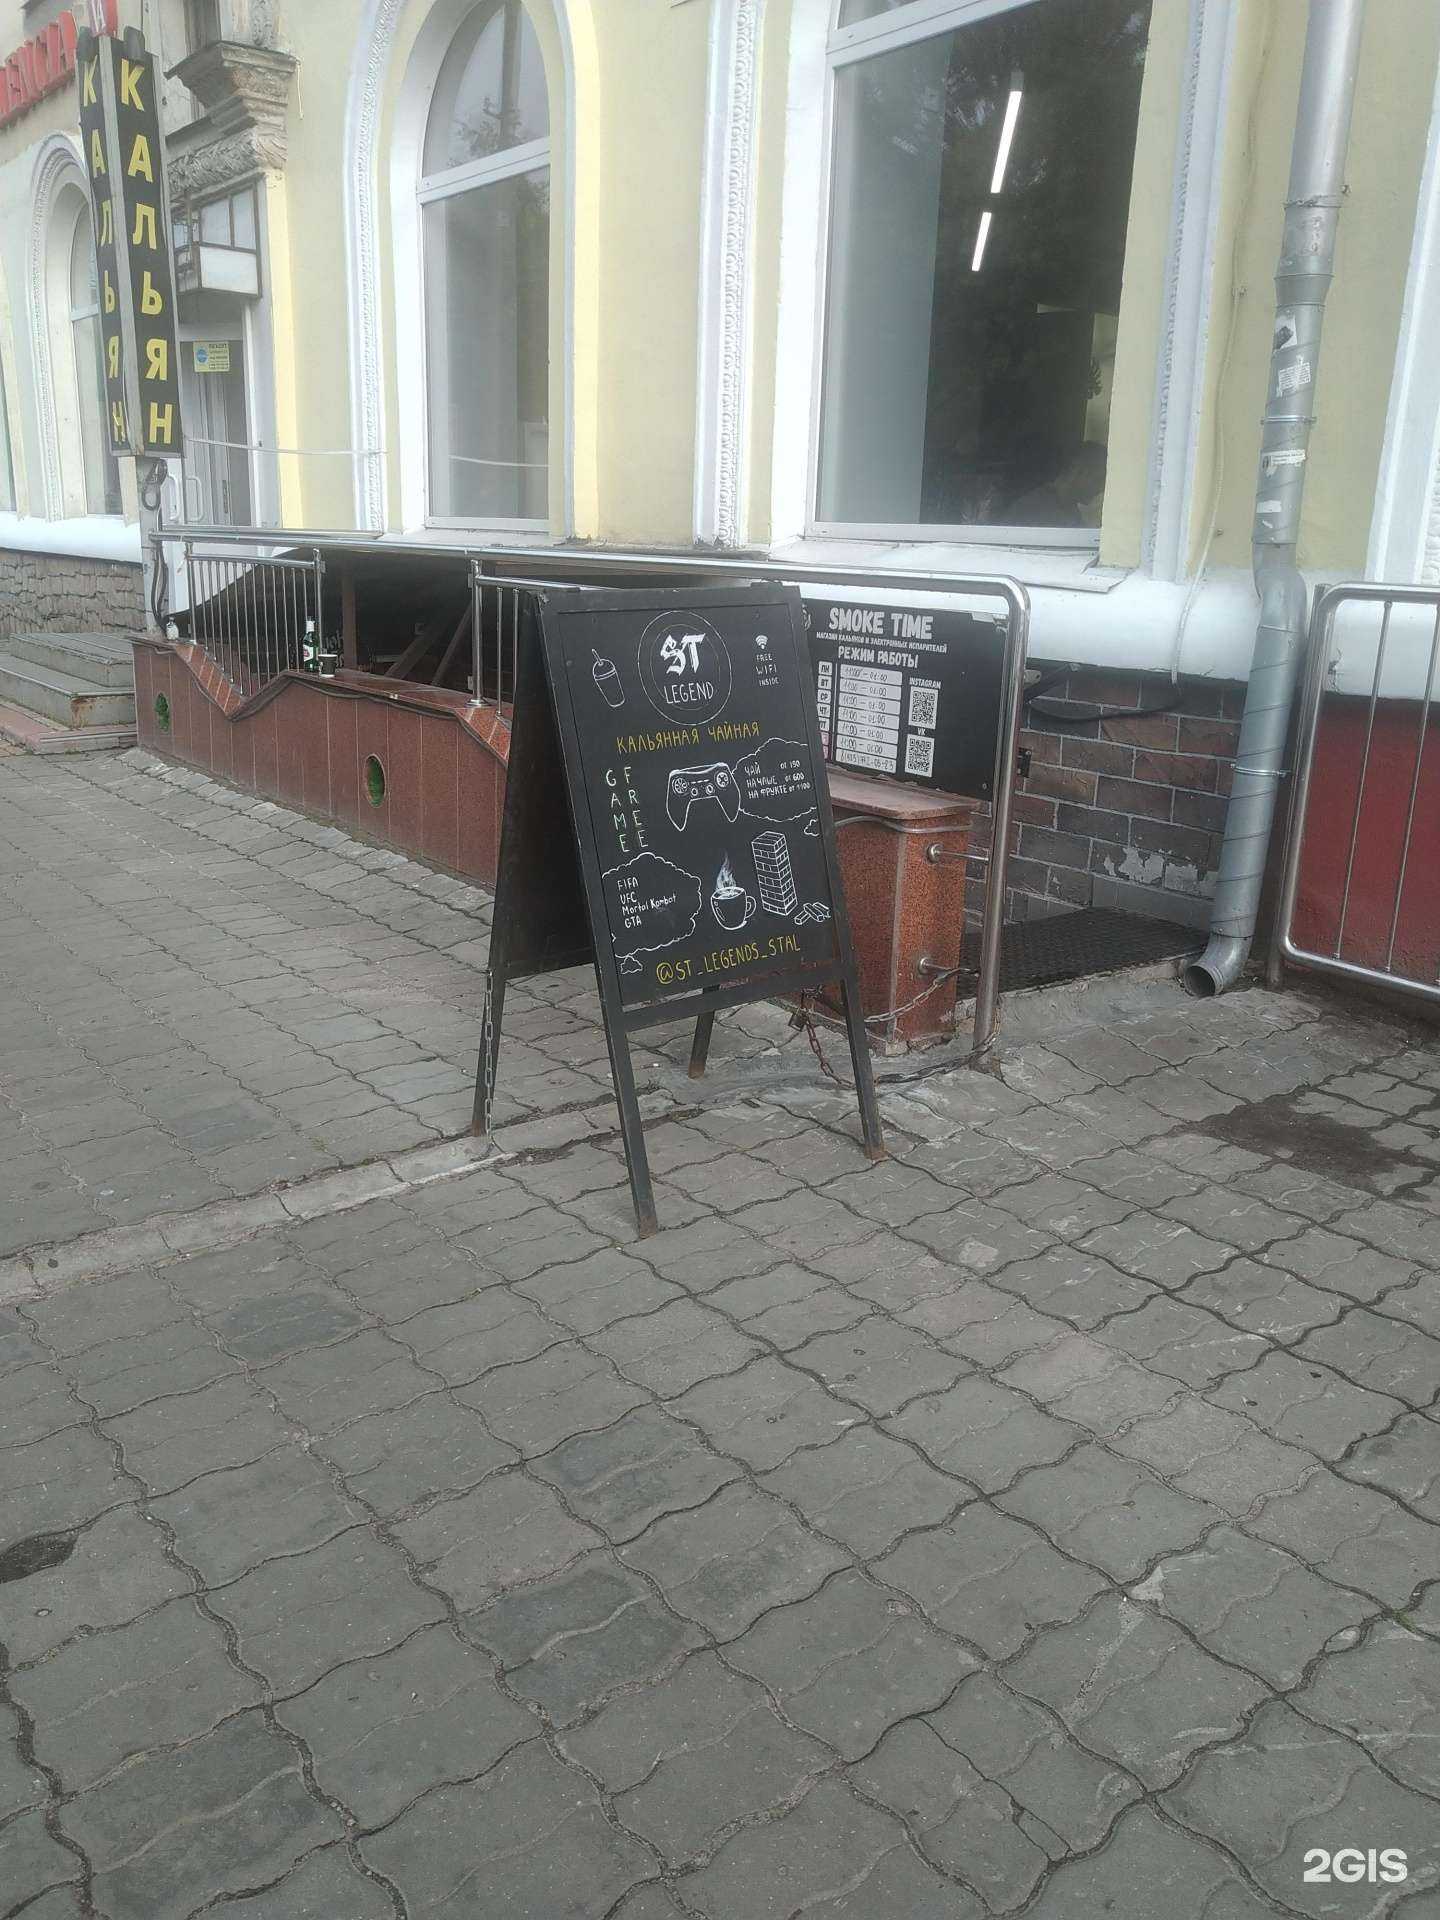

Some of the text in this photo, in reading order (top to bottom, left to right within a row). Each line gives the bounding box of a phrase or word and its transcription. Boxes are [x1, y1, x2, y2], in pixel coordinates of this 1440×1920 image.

[82, 54, 126, 446] КАЛЬЯН
[121, 58, 174, 445] КАЛЬЯН
[829, 607, 934, 640] SMOKE TIME
[816, 631, 838, 641] МАГАЗИН
[908, 642, 948, 654] ИСПАРИТЕЛЕЙ
[660, 633, 706, 676] ST
[756, 653, 773, 662] FREE
[838, 645, 919, 669] РЕЖИМ РАБОТЫ
[821, 664, 830, 672] ПН
[821, 678, 829, 687] ВТ
[909, 676, 941, 690] INSTAGRAM
[664, 681, 714, 704] LEGEND
[820, 692, 829, 700] СР
[819, 706, 828, 714] ЧТ
[617, 720, 760, 755] КАЛЬЯННАЯ ЧАЙНАЯ
[917, 727, 926, 736] VK
[744, 761, 760, 776] ЧАЙ
[792, 772, 805, 781] 600
[748, 790, 759, 799] НА
[760, 784, 788, 796] ФРУКТЕ
[606, 769, 630, 852] GAME
[624, 766, 648, 847] FREE
[617, 877, 639, 890] FIFA
[620, 891, 637, 905] UFC
[621, 900, 649, 916] Mortal
[624, 915, 642, 929] GTA
